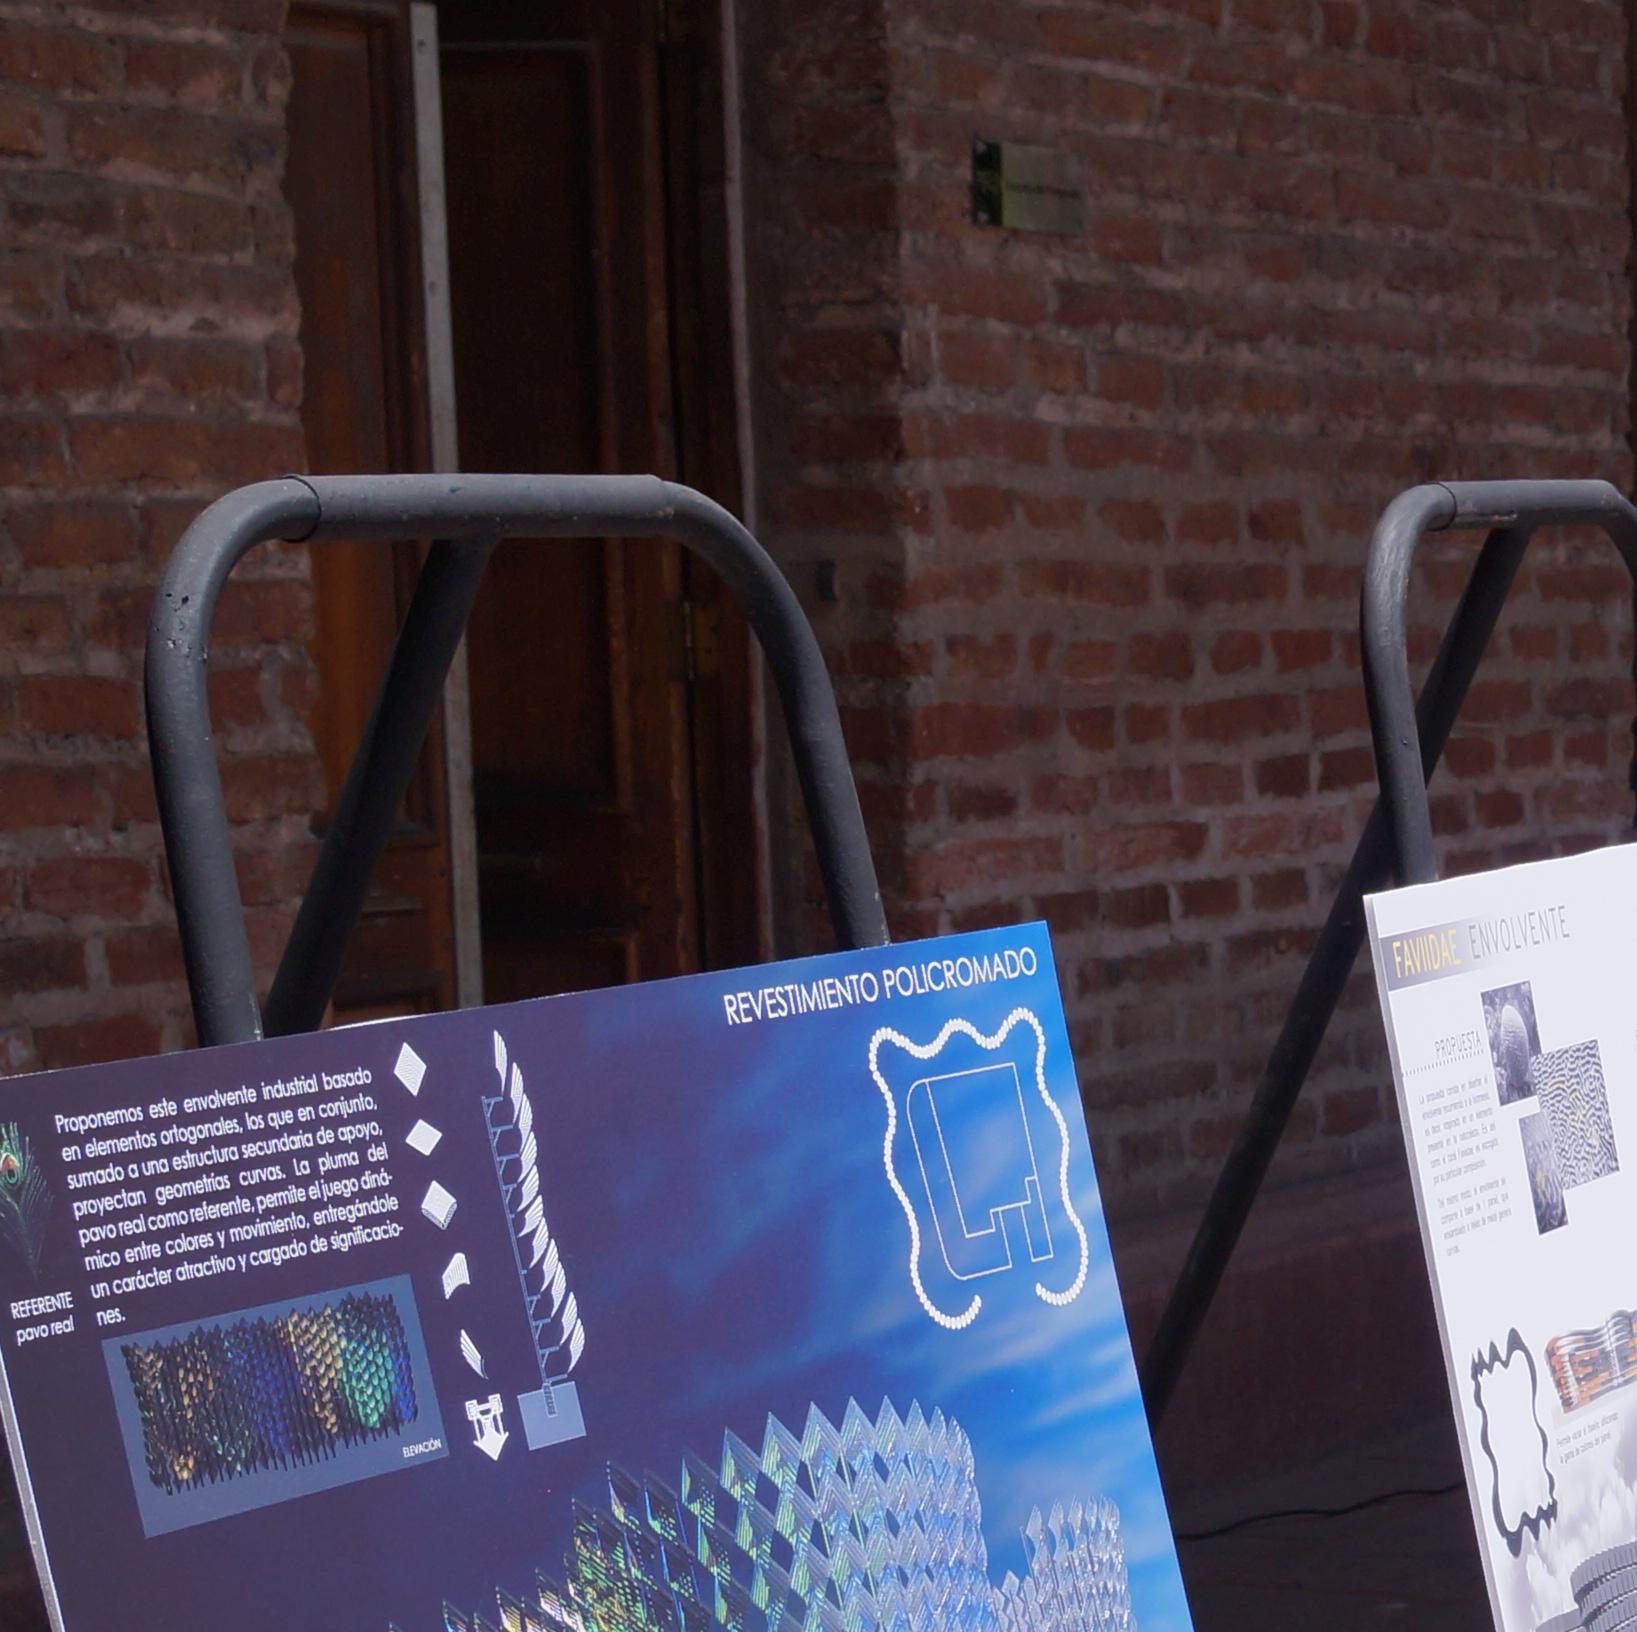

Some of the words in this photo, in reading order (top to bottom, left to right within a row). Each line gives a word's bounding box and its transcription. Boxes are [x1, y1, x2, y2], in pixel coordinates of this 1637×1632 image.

[1392, 928, 1462, 978] FAVIIDAE
[1468, 905, 1570, 960] ENVOLVENTE
[723, 972, 879, 1025] REVESTIMIENTO
[882, 946, 1037, 999] POLICROMADO
[1434, 1031, 1482, 1058] PROPUESTA
[55, 1106, 143, 1134] Proponemos
[149, 1098, 178, 1119] este
[184, 1085, 256, 1113] envolvente
[261, 1074, 318, 1100] industrial
[322, 1066, 372, 1090] basado
[62, 1144, 81, 1162] en
[86, 1129, 157, 1159] elementos
[160, 1115, 243, 1145] ortogonales,
[245, 1111, 264, 1130] los
[268, 1108, 294, 1129] que
[298, 1106, 315, 1122] en
[318, 1094, 378, 1121] conjunto,
[67, 1163, 124, 1190] sumado
[128, 1163, 140, 1179] a
[142, 1156, 169, 1177] una
[173, 1145, 239, 1172] estructura
[242, 1131, 314, 1159] secundaria
[316, 1126, 335, 1142] de
[338, 1121, 383, 1144] apoyo,
[73, 1189, 146, 1220] proyectan
[239, 1165, 286, 1186] curvas.
[293, 1158, 310, 1176] La
[318, 1151, 359, 1175] pluma
[367, 1142, 389, 1162] del
[78, 1222, 116, 1248] pavo
[119, 1212, 146, 1234] real
[147, 1212, 188, 1231] como
[190, 1195, 255, 1223] referente,
[256, 1186, 306, 1214] permite
[309, 1180, 320, 1200] el
[320, 1177, 358, 1202] juego
[84, 1250, 121, 1271] mico
[124, 1242, 161, 1265] entre
[165, 1230, 215, 1255] colores
[218, 1232, 226, 1249] y
[229, 1212, 310, 1243] movimiento,
[313, 1195, 399, 1226] entregándole
[90, 1281, 110, 1299] un
[112, 1269, 172, 1296] carácter
[175, 1256, 236, 1283] atractivo
[238, 1254, 247, 1273] y
[250, 1239, 307, 1267] cargado
[310, 1236, 328, 1253] de
[331, 1221, 404, 1252] significacio-
[11, 1291, 74, 1320] REFERENTE
[16, 1326, 49, 1346] pavo
[50, 1315, 75, 1336] real
[97, 1306, 126, 1326] nes.
[402, 1437, 442, 1458] ELEVACIÓN
